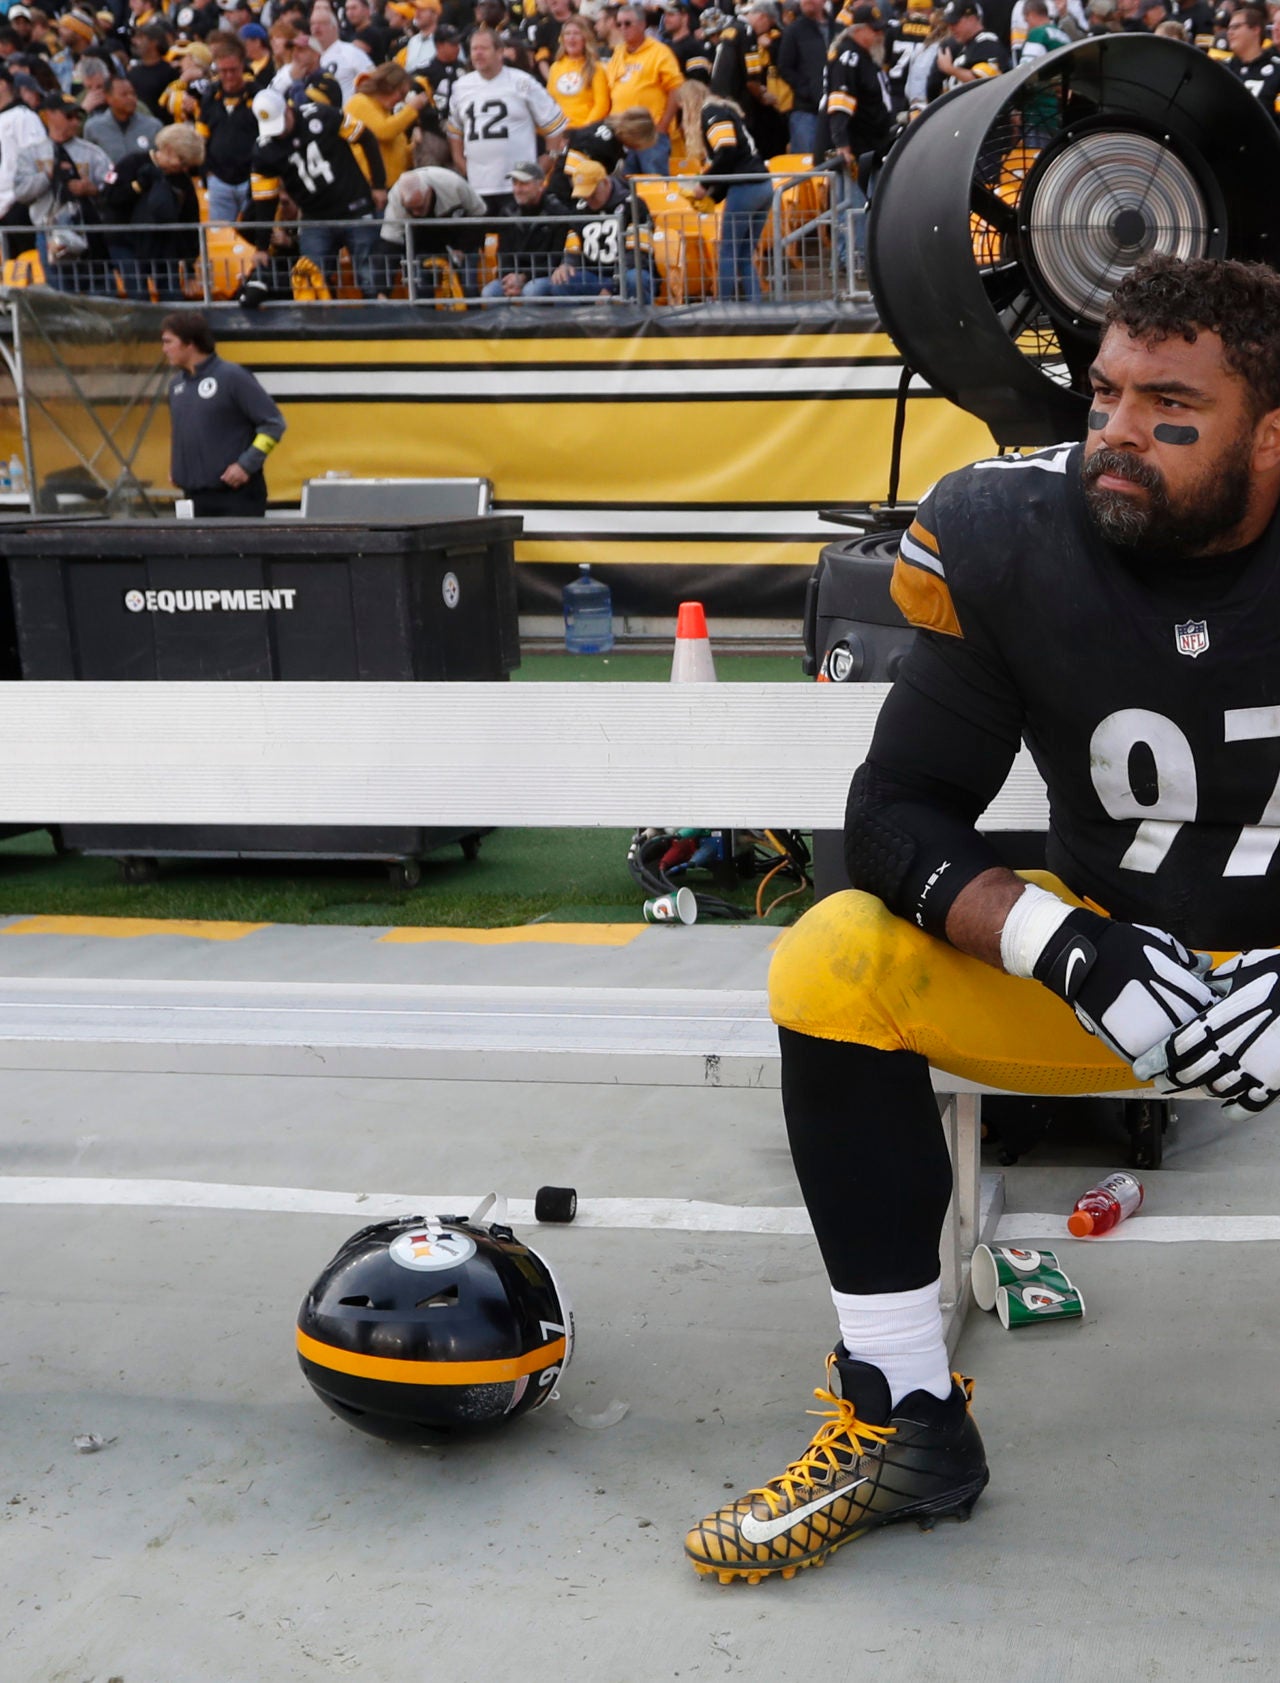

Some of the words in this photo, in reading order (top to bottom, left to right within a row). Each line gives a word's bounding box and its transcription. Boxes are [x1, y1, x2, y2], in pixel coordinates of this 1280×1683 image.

[465, 99, 509, 142] 12
[289, 141, 335, 194] 14
[582, 218, 620, 264] 83
[146, 588, 297, 614] EQUIPMENT
[1181, 633, 1204, 650] NFL
